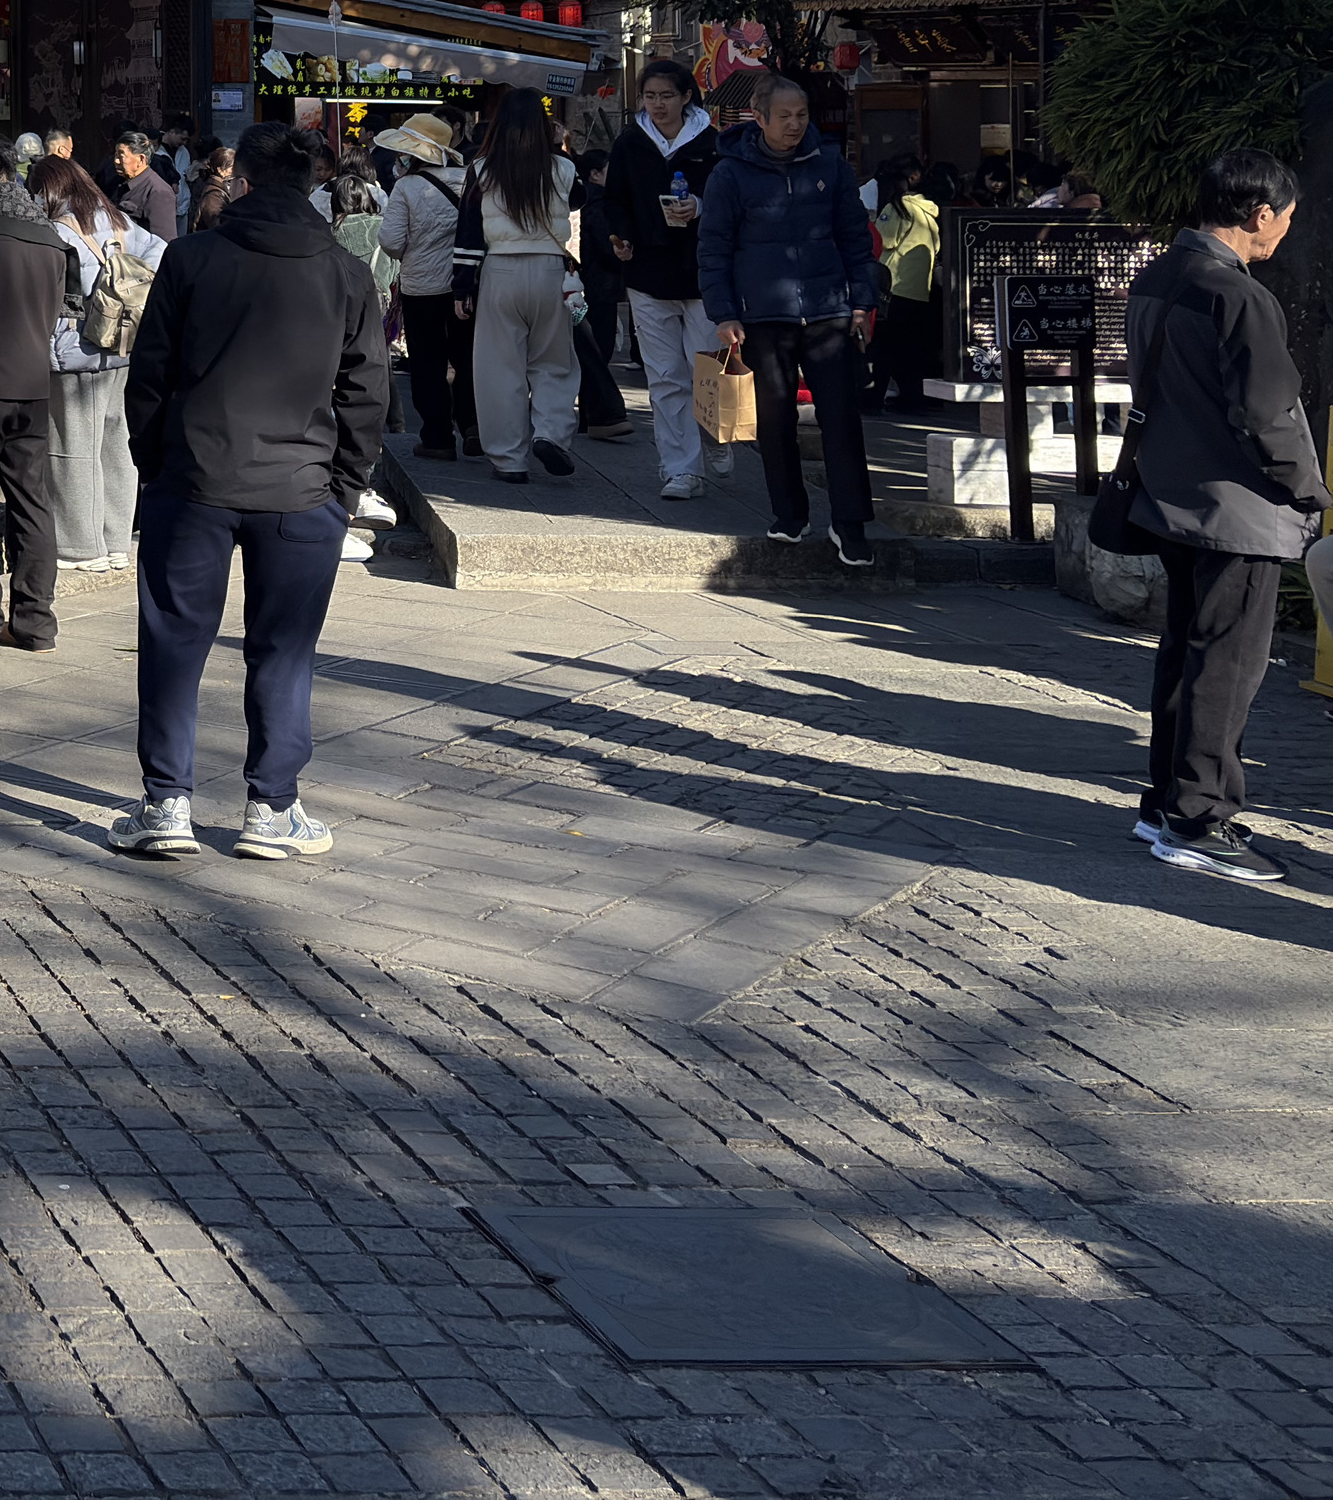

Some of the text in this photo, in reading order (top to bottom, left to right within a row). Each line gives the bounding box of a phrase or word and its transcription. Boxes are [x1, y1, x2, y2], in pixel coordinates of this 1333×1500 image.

[1037, 283, 1091, 296] 当心落水
[1039, 316, 1093, 330] 当心楼梯
